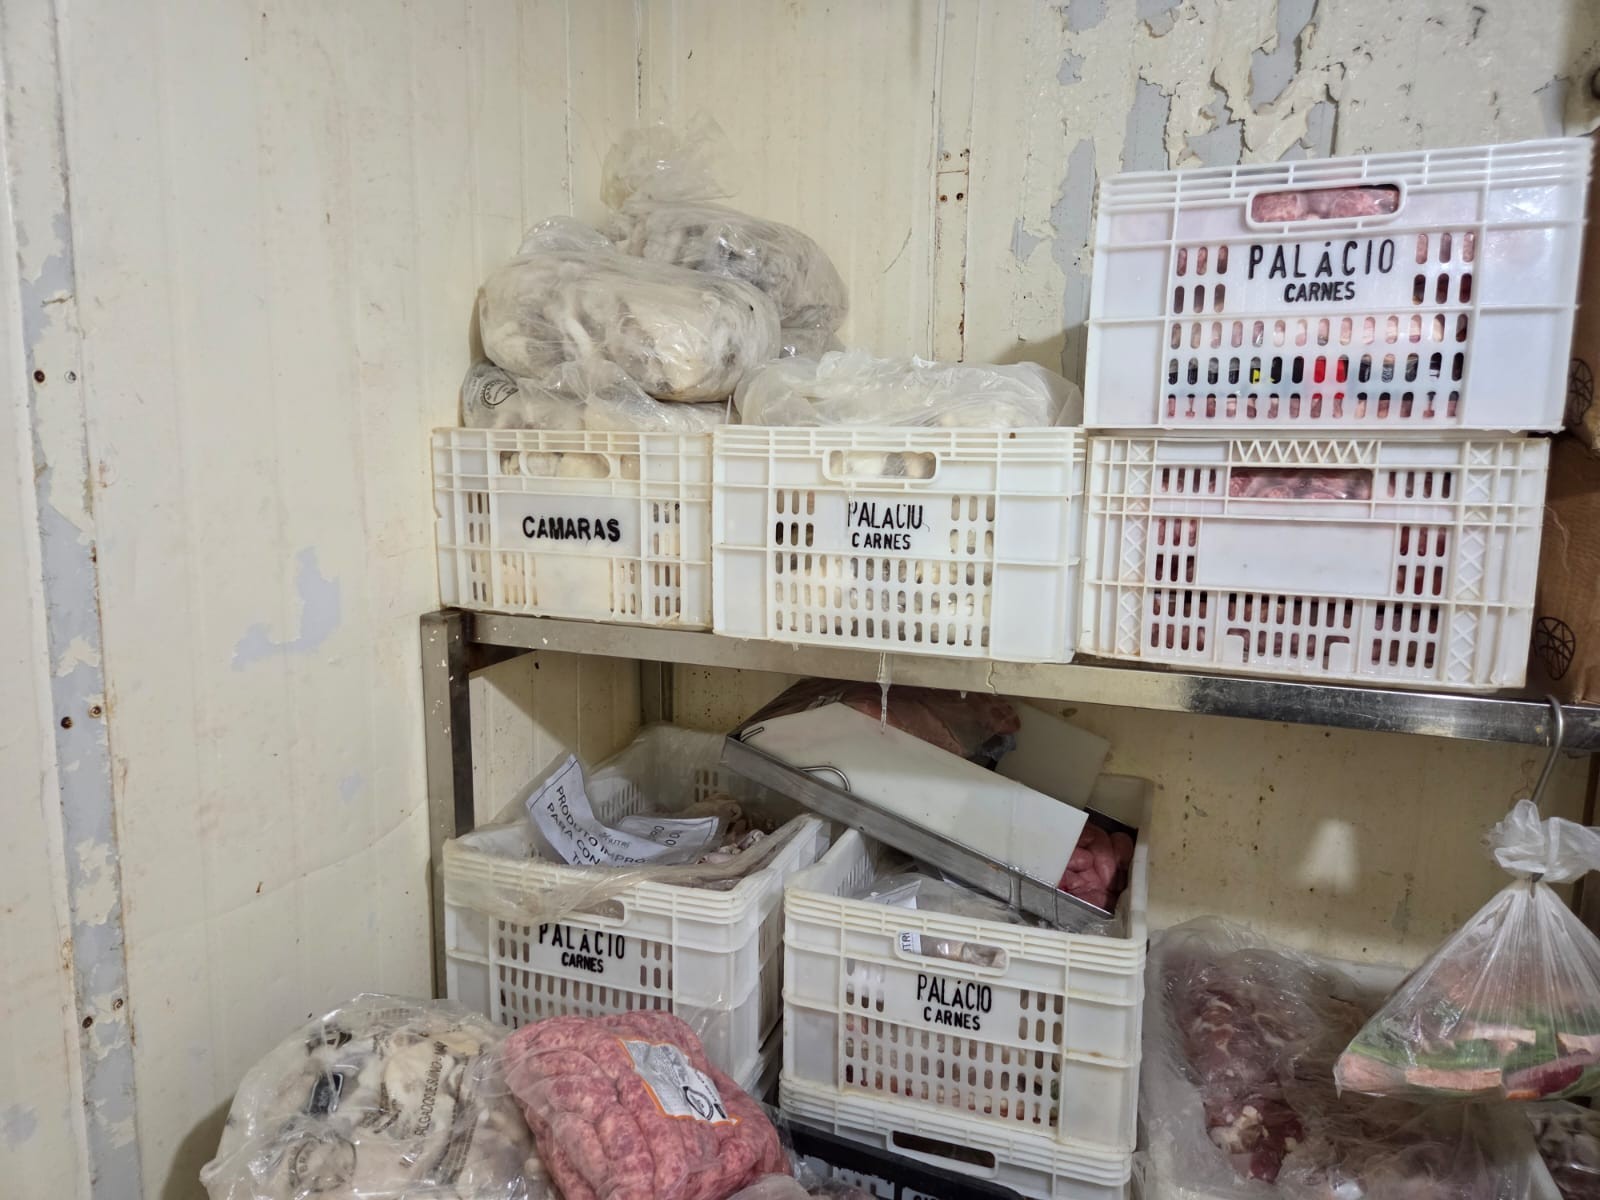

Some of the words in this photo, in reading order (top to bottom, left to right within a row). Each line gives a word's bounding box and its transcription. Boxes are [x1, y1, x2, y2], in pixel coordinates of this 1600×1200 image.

[1248, 239, 1395, 281] PALÁCIO
[1283, 281, 1356, 303] CARNES
[852, 532, 911, 550] CARNES
[556, 785, 599, 847] PRODUTO
[546, 802, 574, 840] PARA
[576, 839, 601, 865] CON
[561, 951, 605, 974] CARNES
[916, 973, 993, 1014] PALÁCIO
[923, 1006, 982, 1031] CARNES
